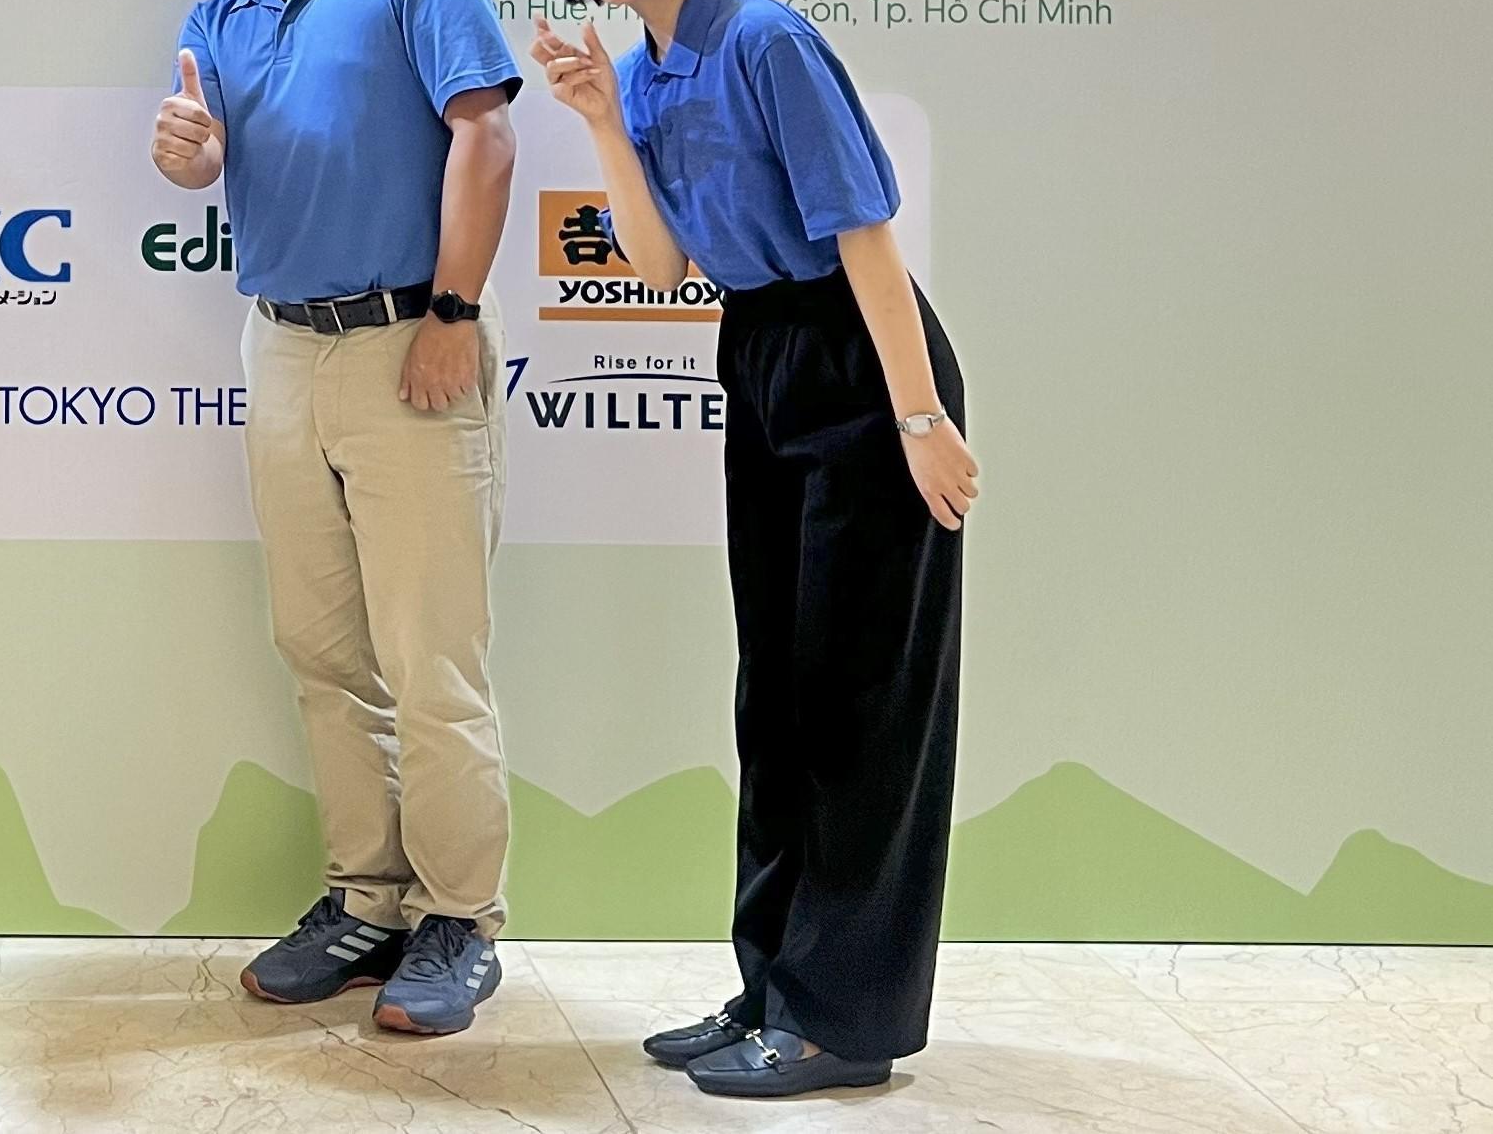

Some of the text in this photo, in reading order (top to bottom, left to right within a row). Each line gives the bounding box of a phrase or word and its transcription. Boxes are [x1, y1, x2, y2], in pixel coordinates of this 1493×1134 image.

[593, 354, 696, 370] Rise for it
[170, 386, 248, 426] THE
[525, 391, 725, 431] WILLTE
